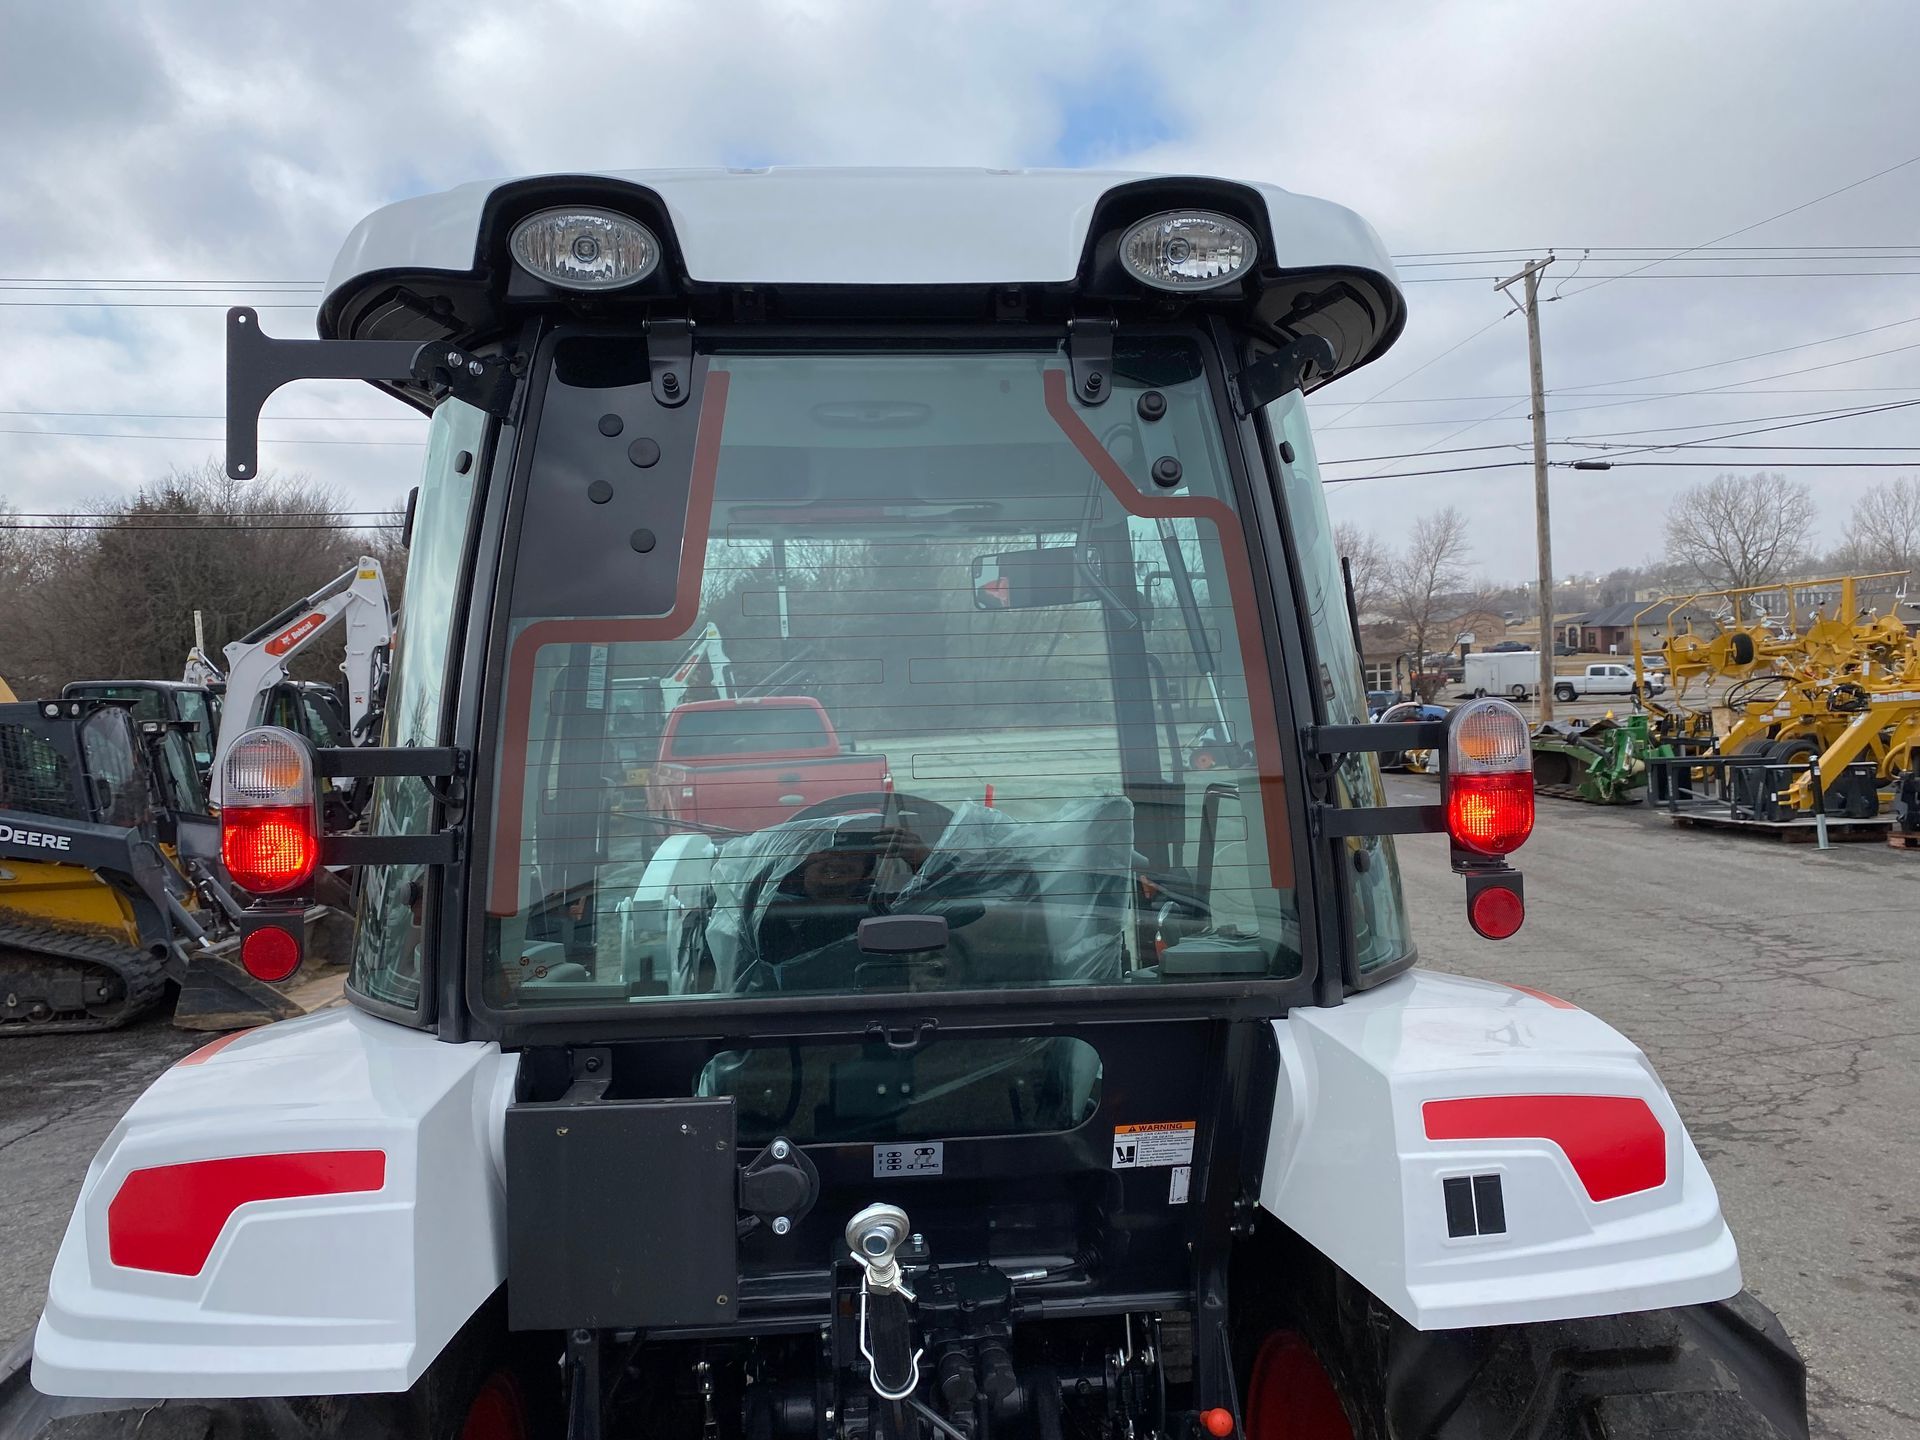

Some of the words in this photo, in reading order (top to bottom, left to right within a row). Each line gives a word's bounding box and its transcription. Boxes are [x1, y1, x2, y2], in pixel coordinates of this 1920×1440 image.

[290, 620, 313, 639] Bobcat
[0, 825, 71, 851] DEERE
[1139, 1123, 1183, 1132] WARNING
